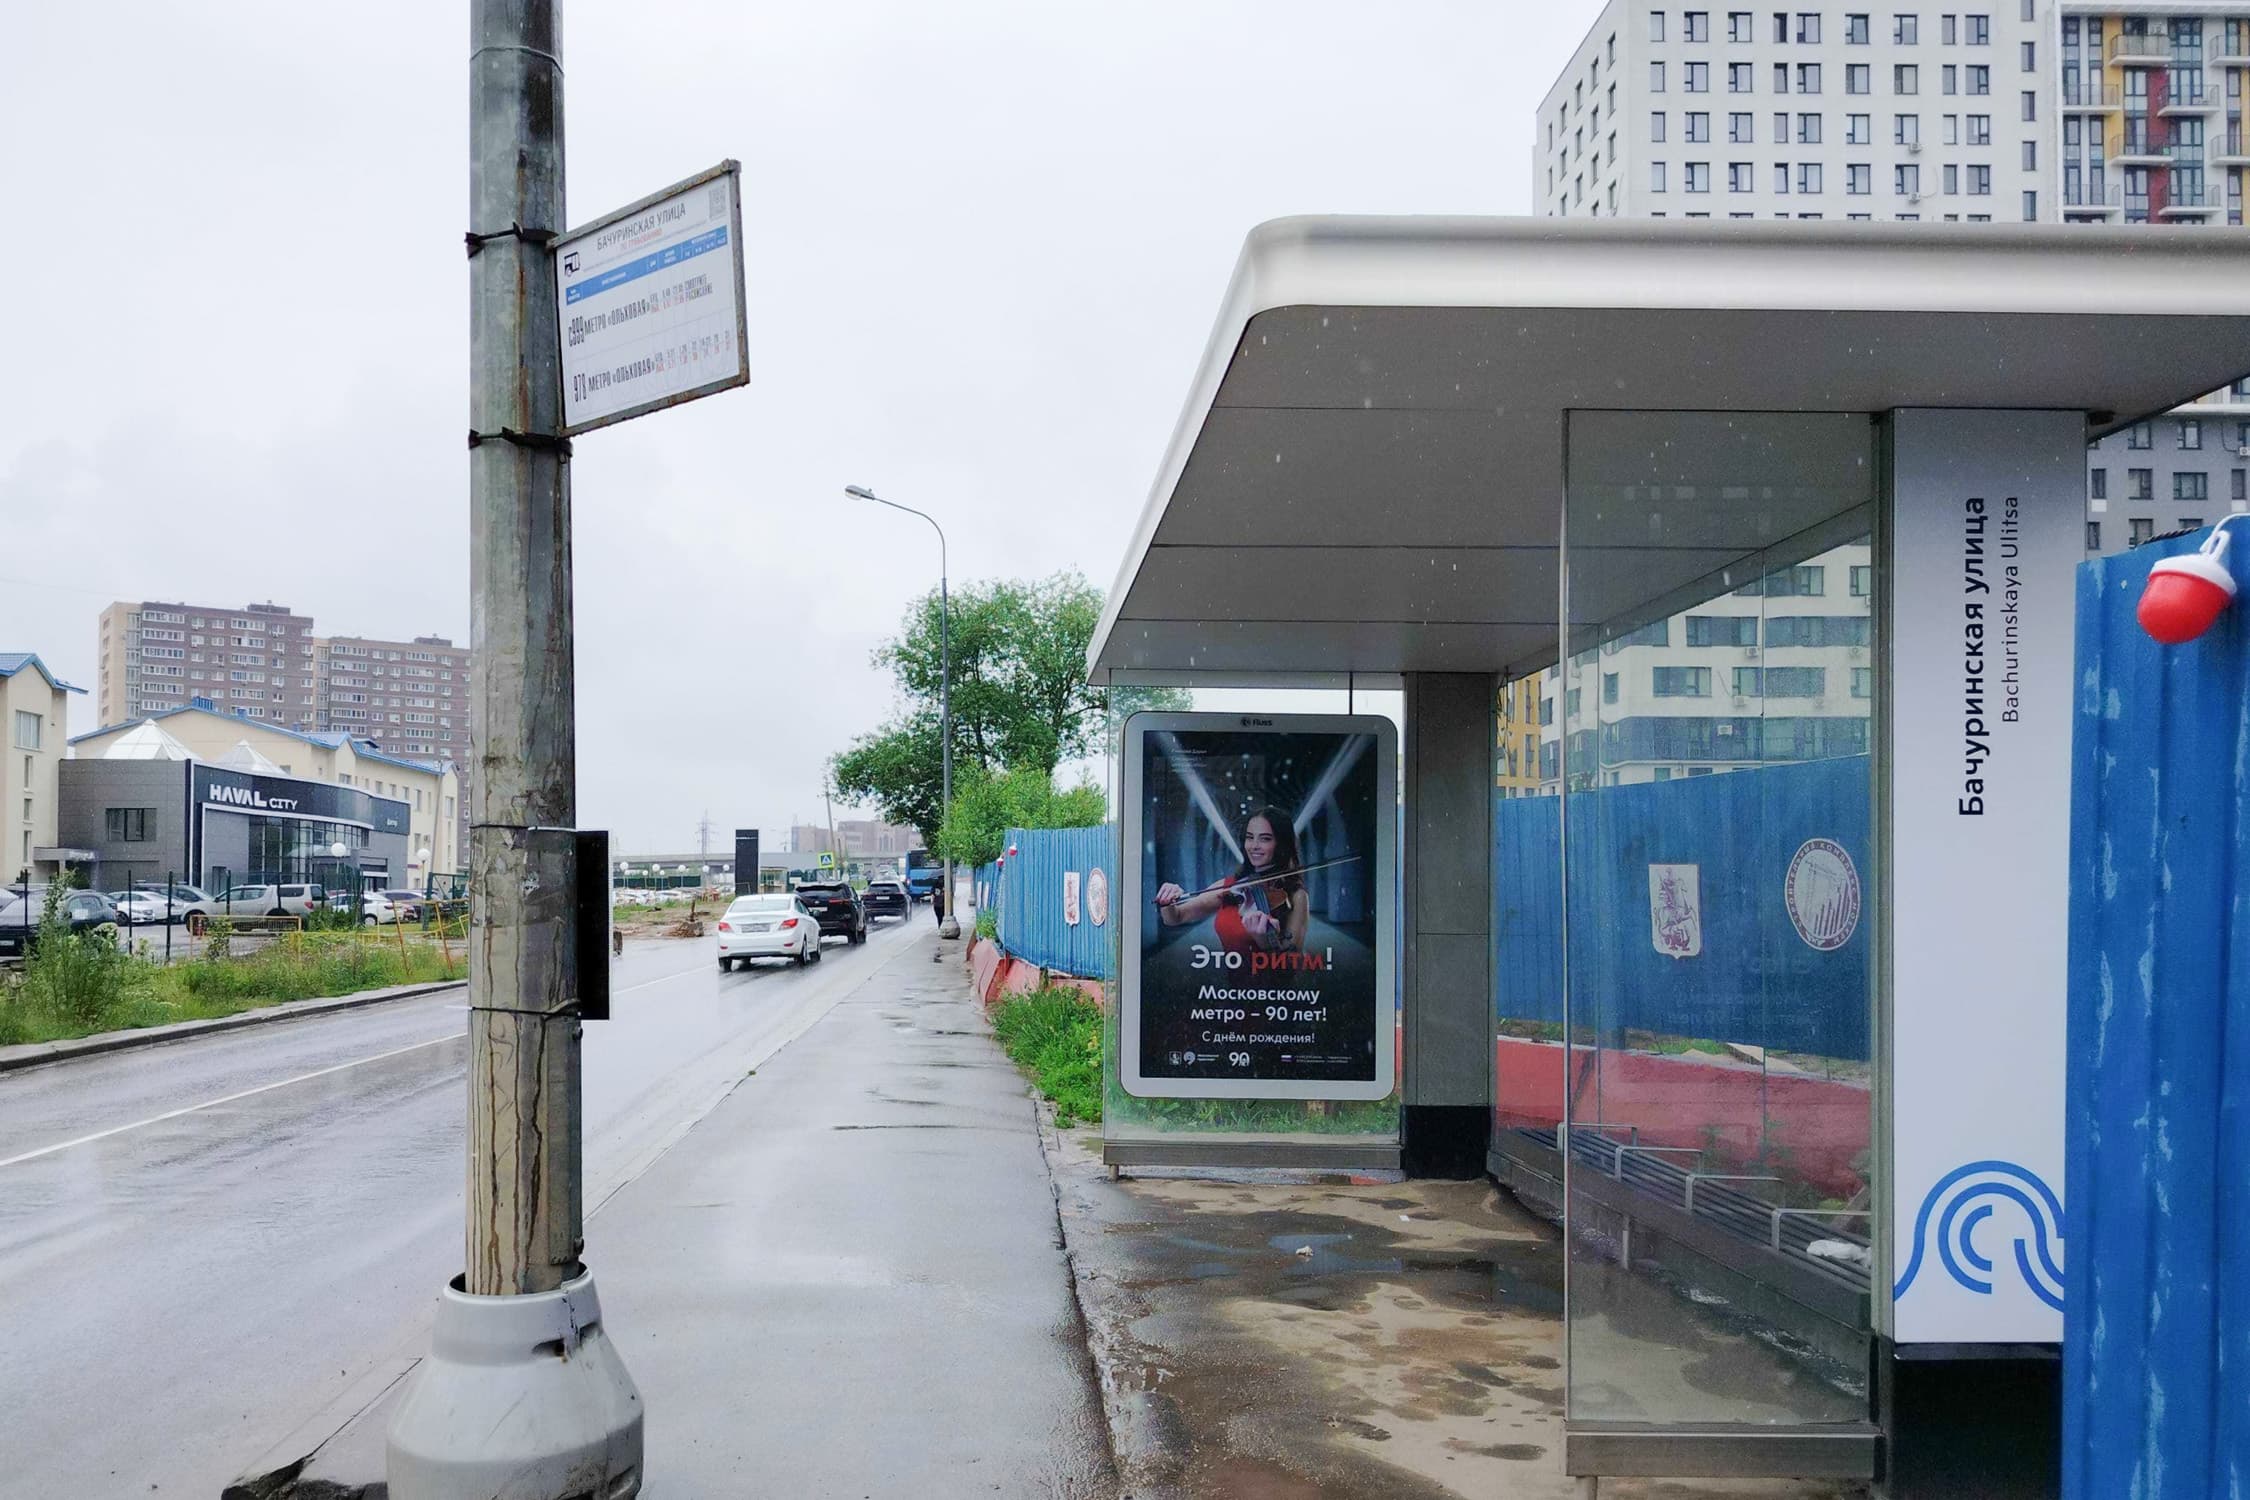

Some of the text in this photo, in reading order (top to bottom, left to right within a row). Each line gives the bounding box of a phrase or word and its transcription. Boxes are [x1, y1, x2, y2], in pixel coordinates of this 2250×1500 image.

[597, 215, 655, 251] БАЧУРИНСКАЯ
[656, 203, 687, 226] УЛИЦА
[585, 313, 607, 336] МЕТРО
[573, 373, 587, 402] 978
[588, 370, 611, 393] МЕТРО
[2000, 497, 2022, 722] Bachurinskaya Ulitsa
[1959, 498, 1991, 816] Бачуринская улица
[209, 784, 298, 810] HAVAL CITY
[1190, 944, 1333, 976] Это ритм!
[1198, 985, 1320, 1005] Московскому
[1190, 1008, 1246, 1023] метро
[1265, 1006, 1288, 1021] 90
[1292, 1007, 1327, 1022] лет!
[1202, 1030, 1315, 1045] С днём рождения!
